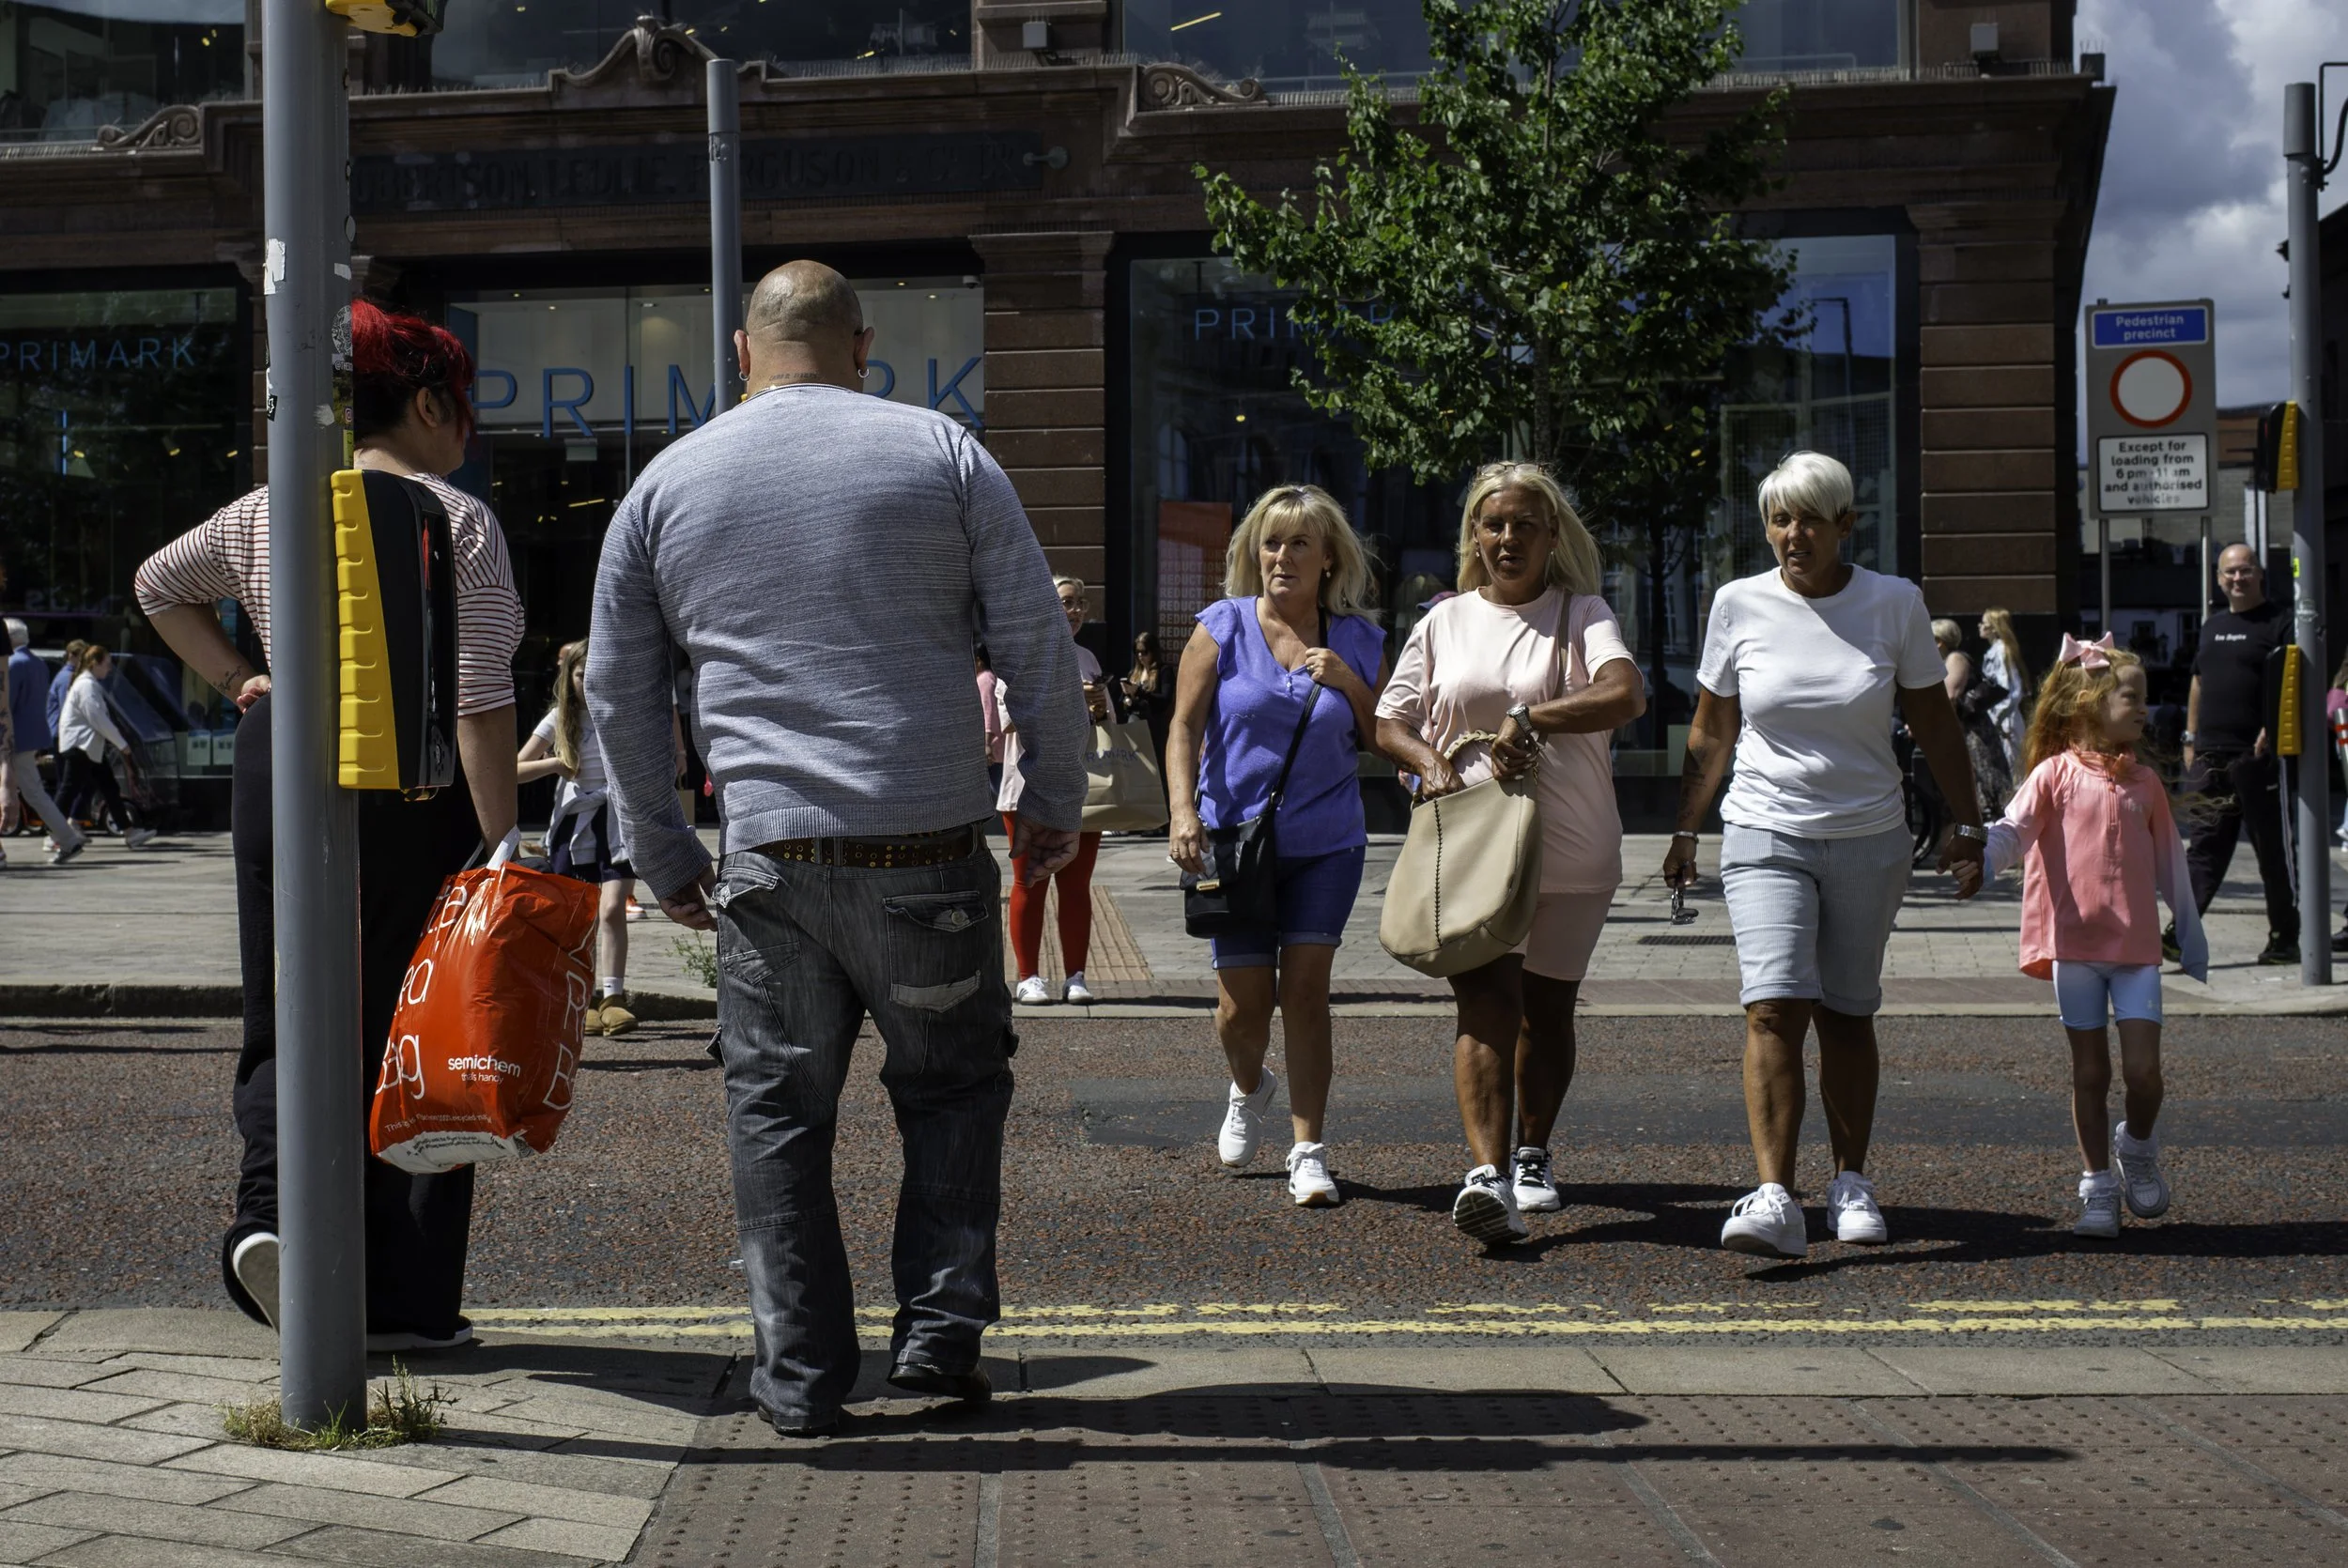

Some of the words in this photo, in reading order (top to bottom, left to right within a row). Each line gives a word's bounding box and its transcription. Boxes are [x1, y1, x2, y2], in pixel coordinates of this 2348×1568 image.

[686, 147, 878, 193] FRGUSON
[2115, 313, 2184, 328] Pedestrian
[2123, 327, 2175, 342] precinct
[467, 356, 982, 438] PRIMRK
[2118, 440, 2163, 453] Except
[2168, 440, 2186, 451] for
[2110, 454, 2158, 467] loading
[2163, 453, 2194, 464] from
[2116, 468, 2124, 479] 6
[2127, 469, 2146, 480] pm
[2105, 482, 2128, 492] and
[2133, 479, 2201, 491] authorised
[448, 1054, 521, 1078] semichem
[478, 1072, 503, 1084] handy
